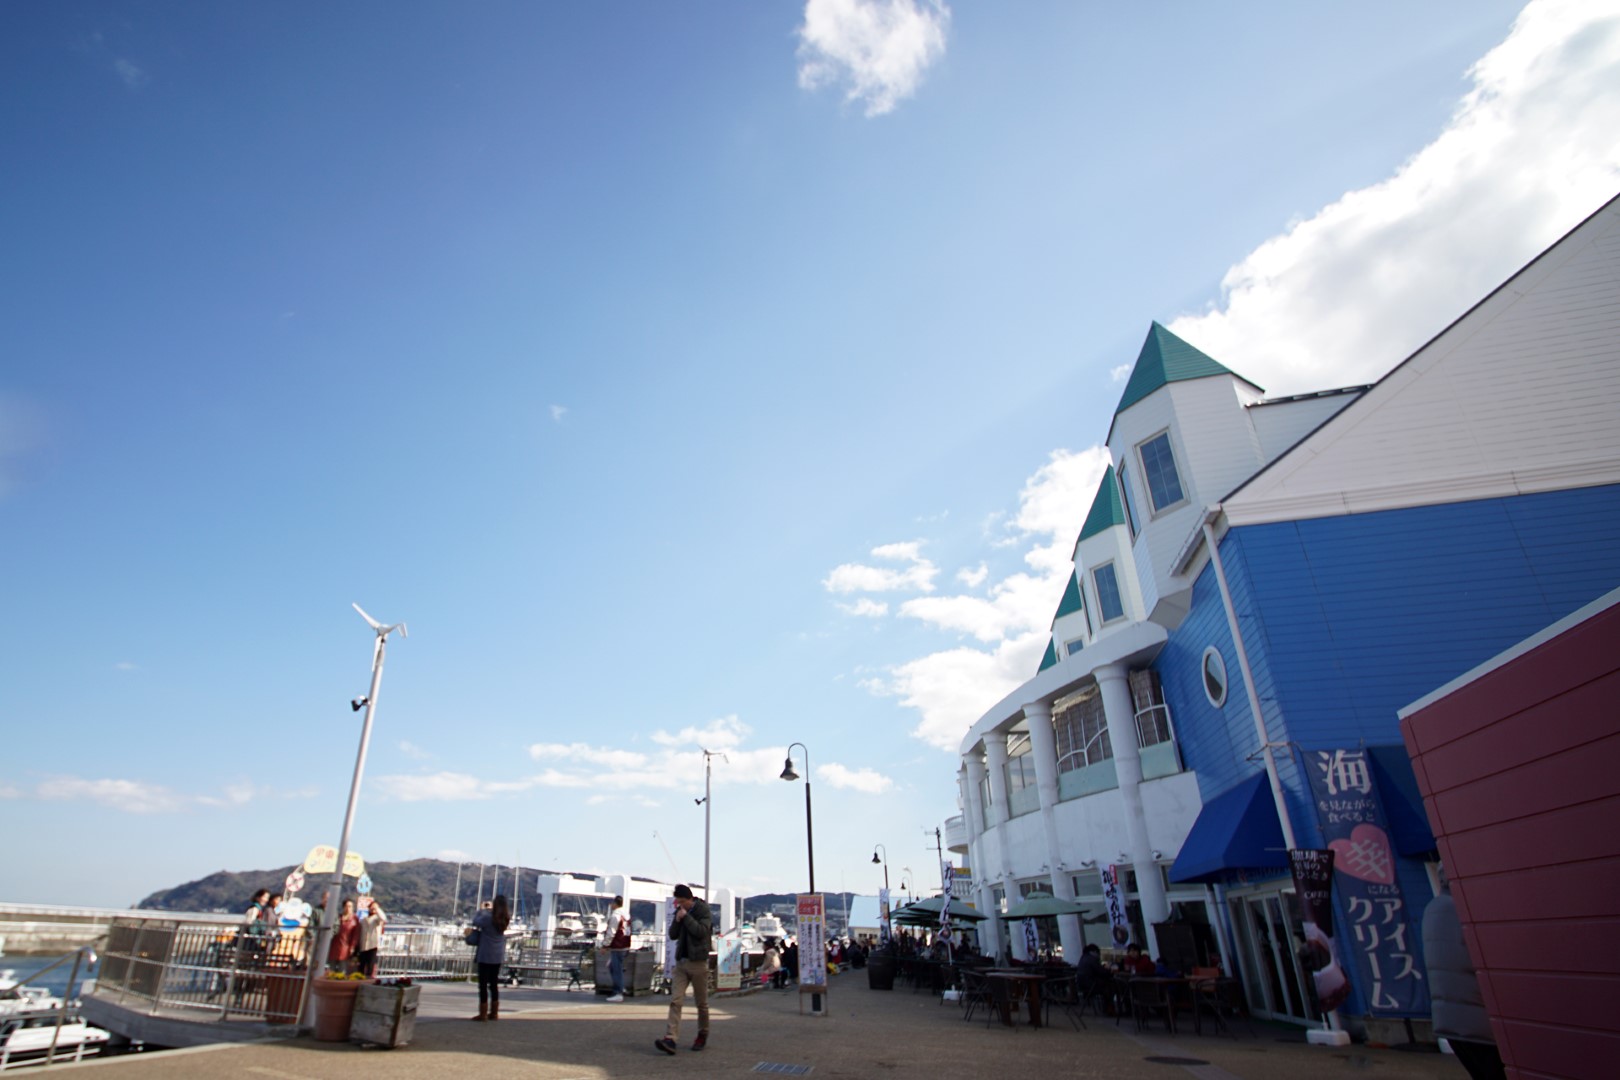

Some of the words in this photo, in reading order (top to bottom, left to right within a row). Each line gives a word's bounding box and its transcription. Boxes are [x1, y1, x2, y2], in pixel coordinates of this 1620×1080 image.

[1317, 749, 1372, 795] 海
[1319, 799, 1376, 812] を見ながら
[1328, 811, 1375, 823] 食べると
[1367, 884, 1399, 895] になる
[1348, 896, 1399, 1009] クリーム
[1373, 897, 1422, 981] アイス
